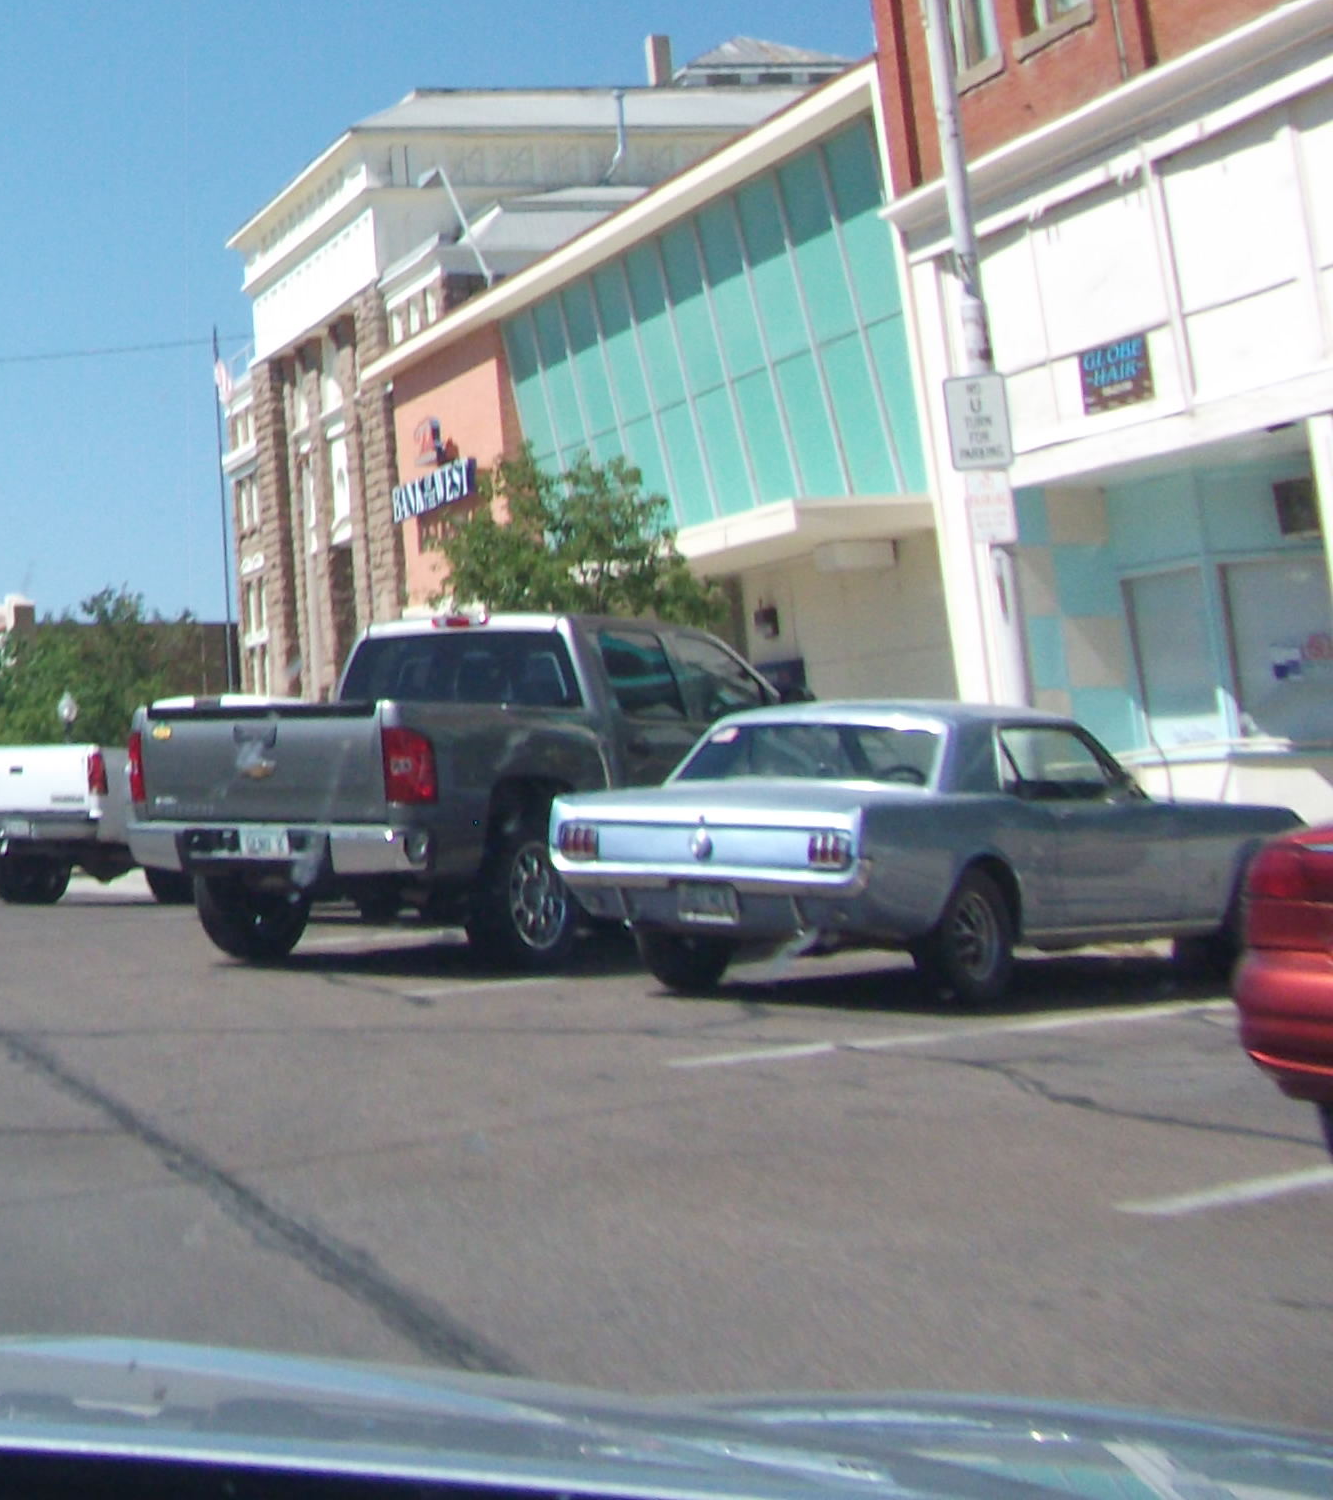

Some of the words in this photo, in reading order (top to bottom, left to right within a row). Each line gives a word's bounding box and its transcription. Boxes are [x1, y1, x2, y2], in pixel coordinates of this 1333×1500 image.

[1083, 337, 1142, 370] GLOBE
[970, 399, 981, 413] U
[964, 416, 992, 429] TURN
[969, 431, 990, 444] FOR
[959, 445, 1005, 460] PARKING
[393, 477, 425, 524] BANK
[434, 457, 468, 504] WEST
